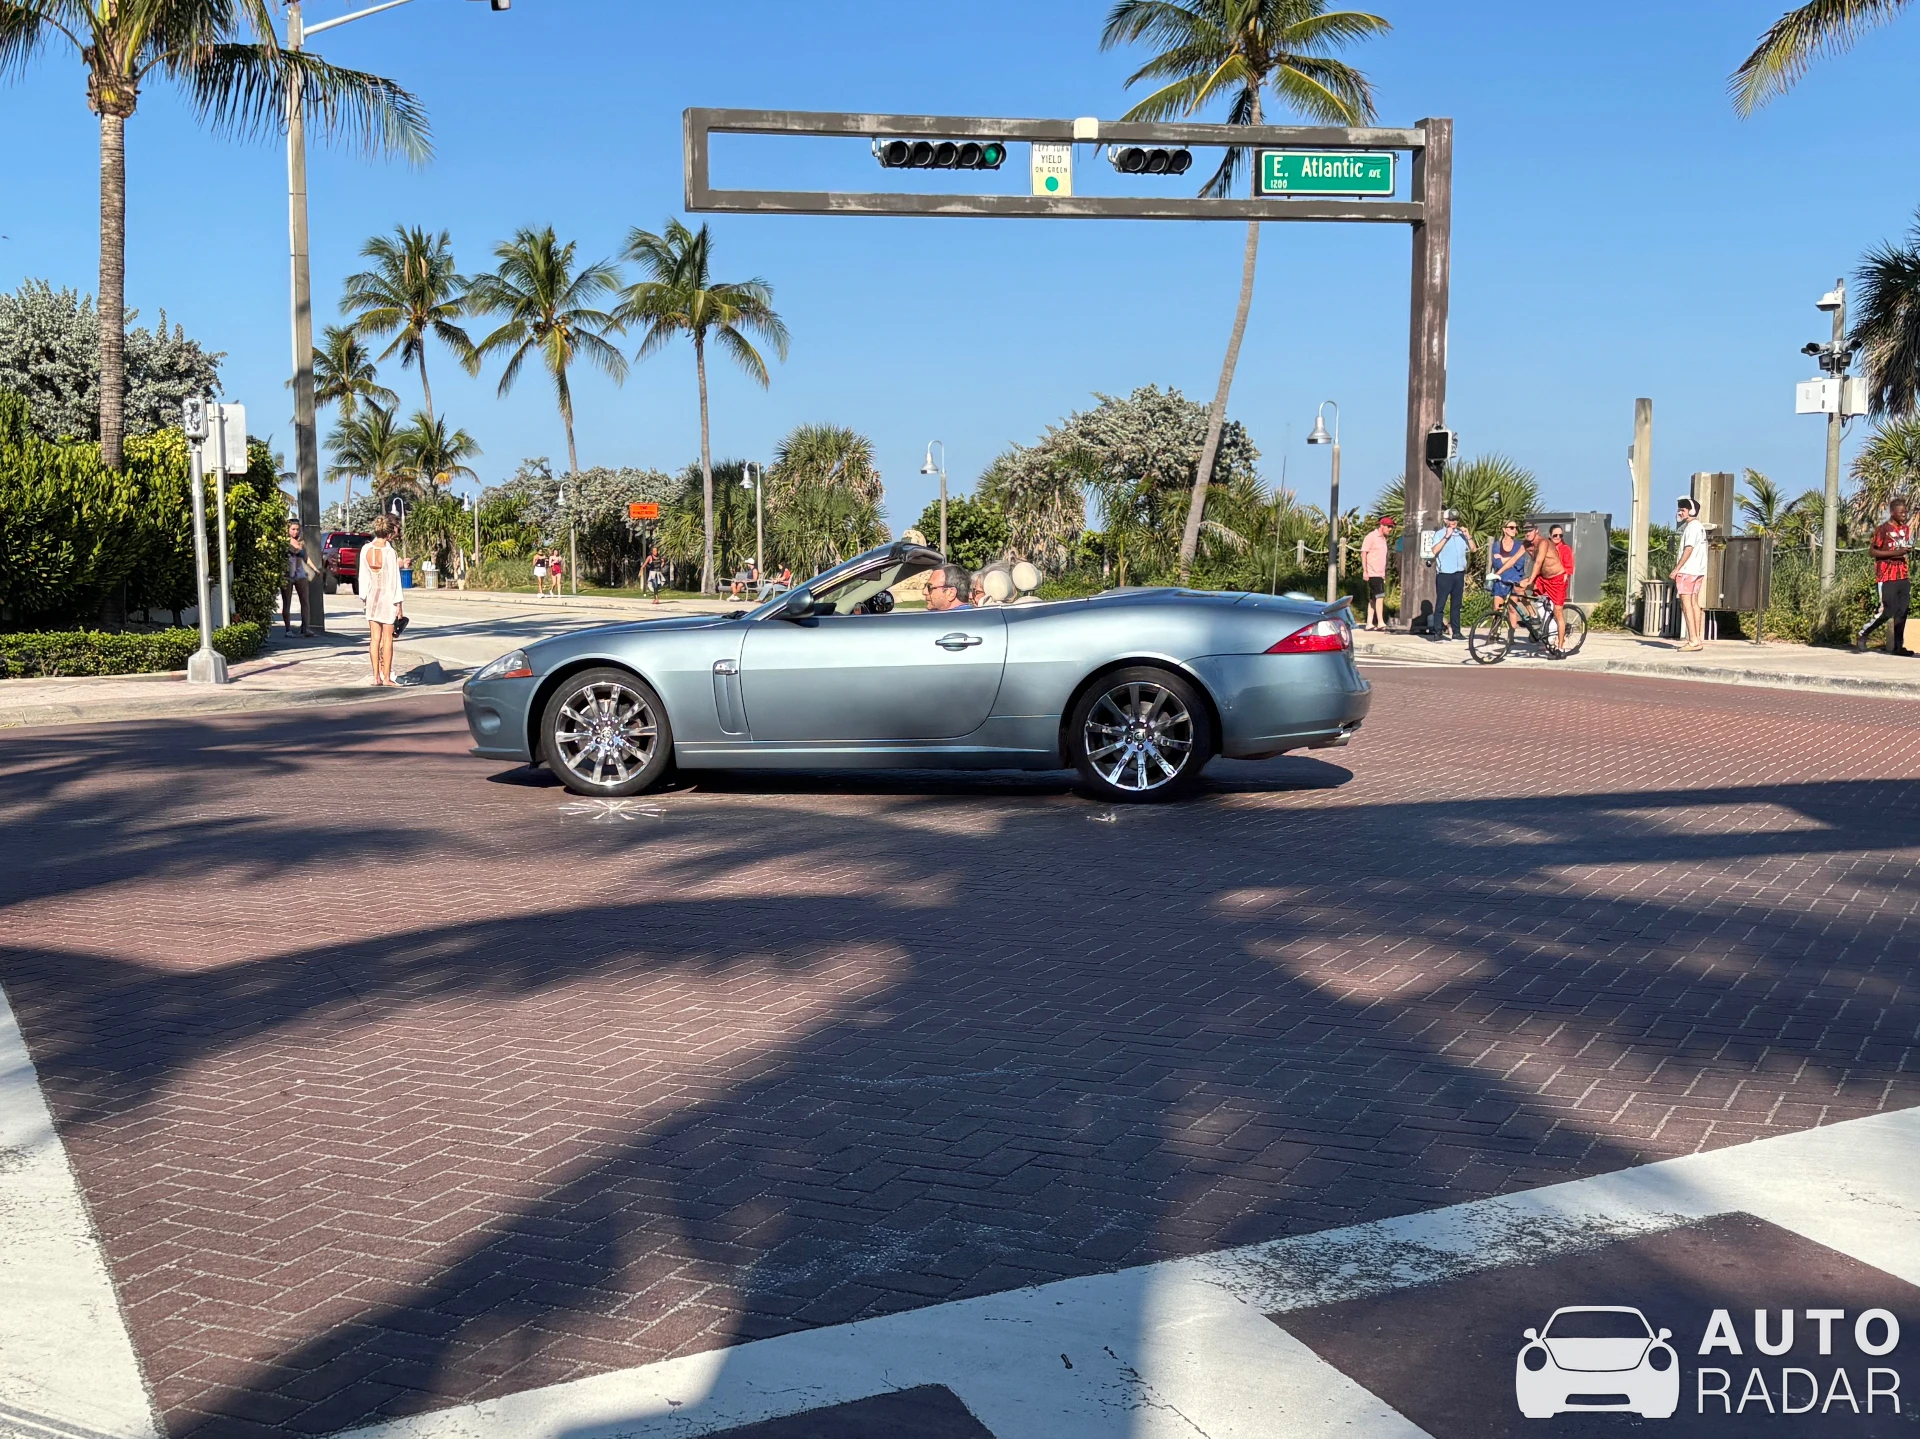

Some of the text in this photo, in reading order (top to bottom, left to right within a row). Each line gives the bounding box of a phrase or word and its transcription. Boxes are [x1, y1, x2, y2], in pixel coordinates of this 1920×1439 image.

[1040, 154, 1062, 164] YIELD
[1047, 166, 1068, 174] GREEN
[1273, 156, 1289, 178] E.
[1301, 157, 1364, 178] Atlantic
